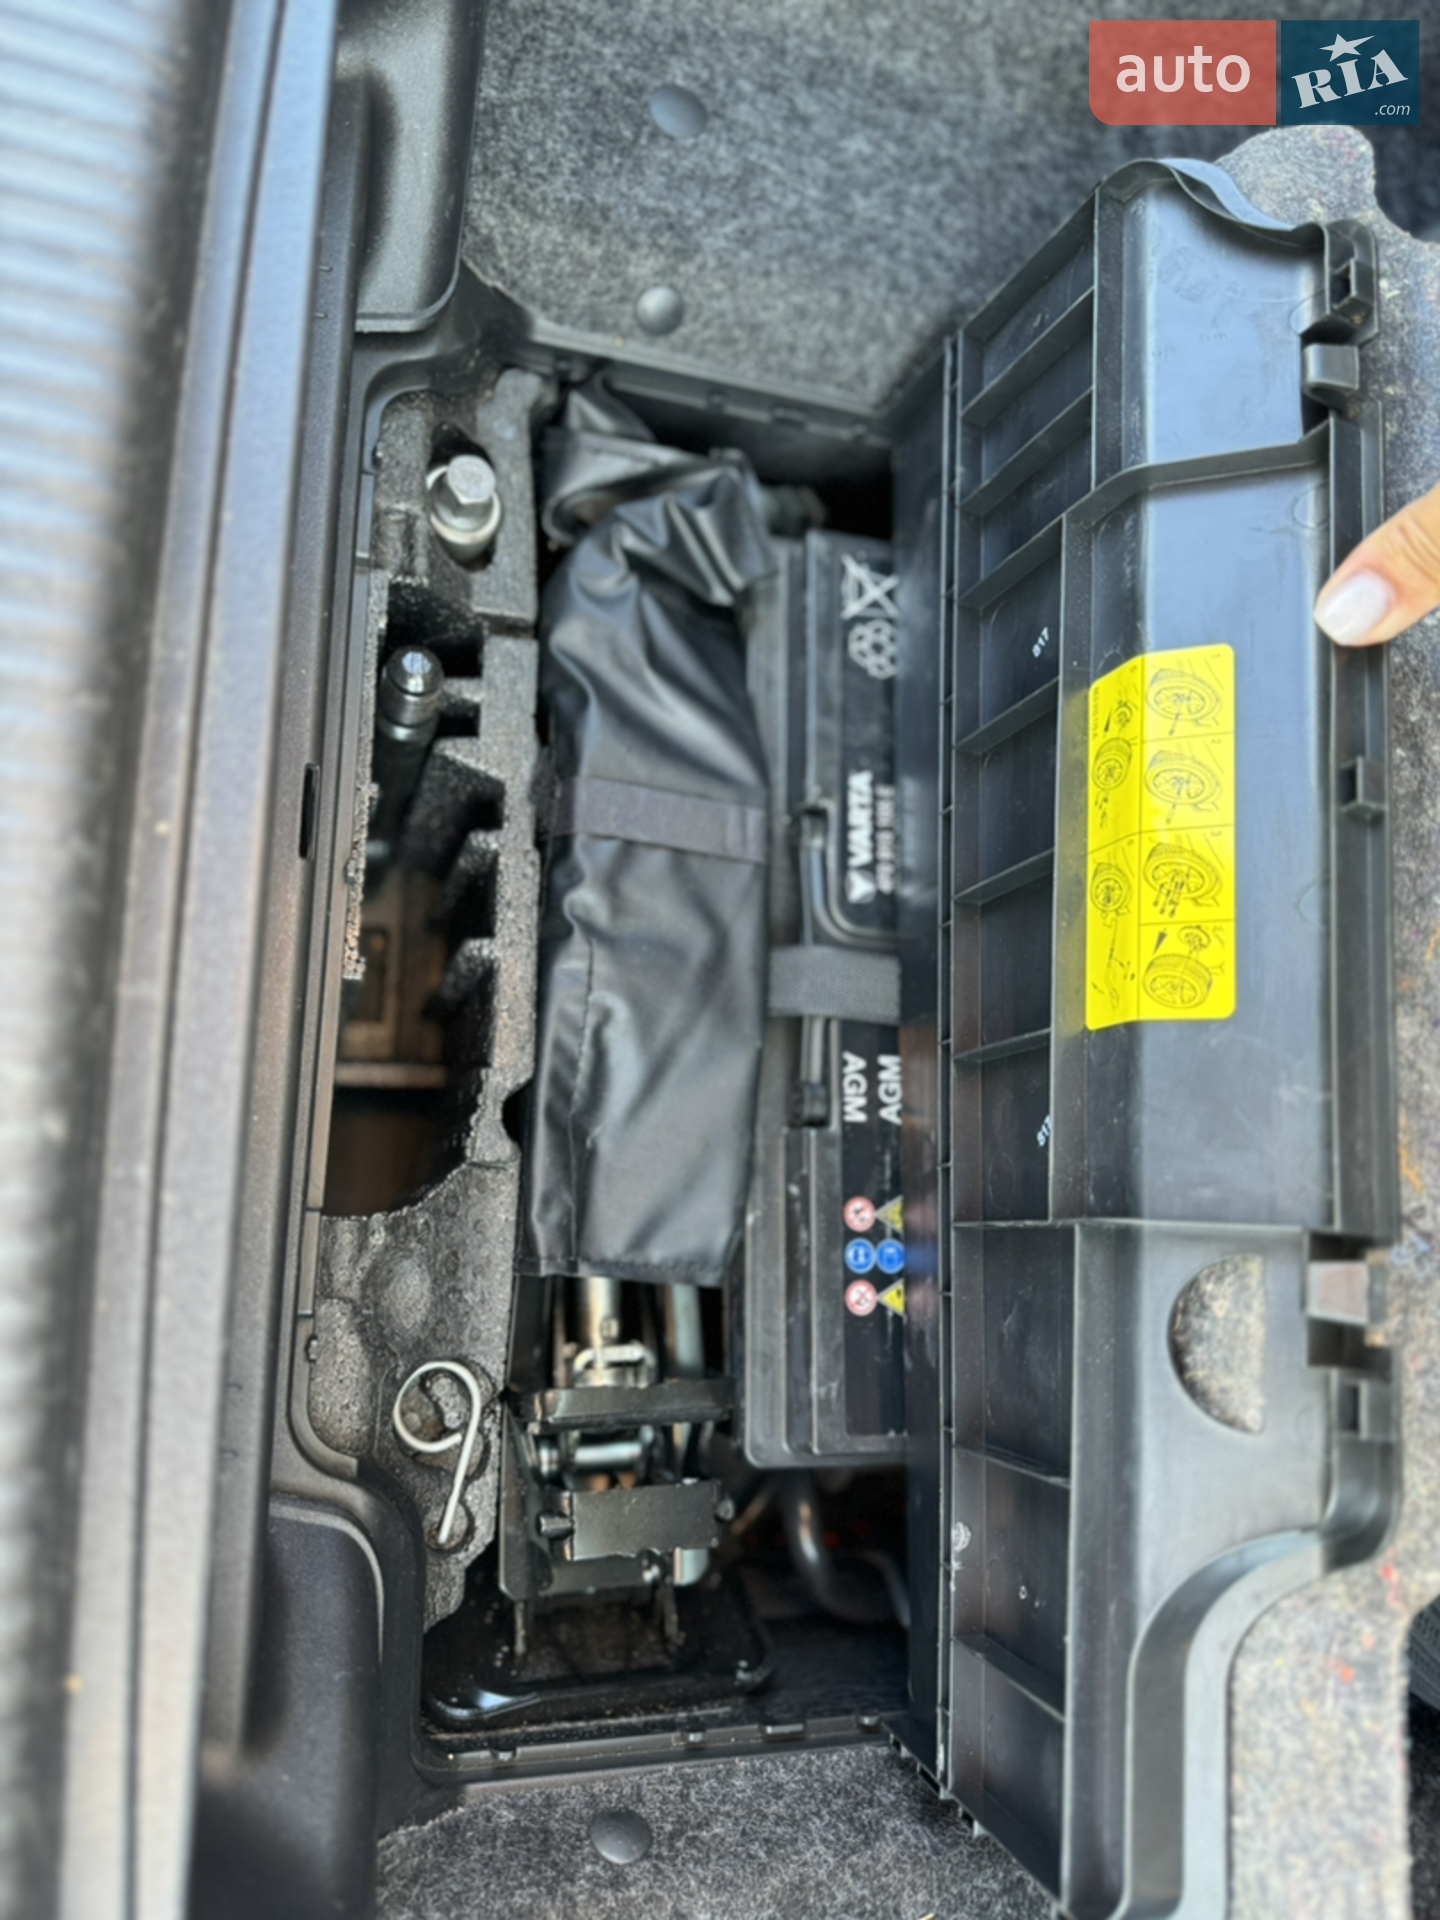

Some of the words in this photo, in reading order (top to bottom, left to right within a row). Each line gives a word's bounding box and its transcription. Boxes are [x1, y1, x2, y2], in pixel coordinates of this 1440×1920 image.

[847, 770, 874, 868] VARTA
[842, 1049, 869, 1124] AGM
[876, 1053, 904, 1127] AGM
